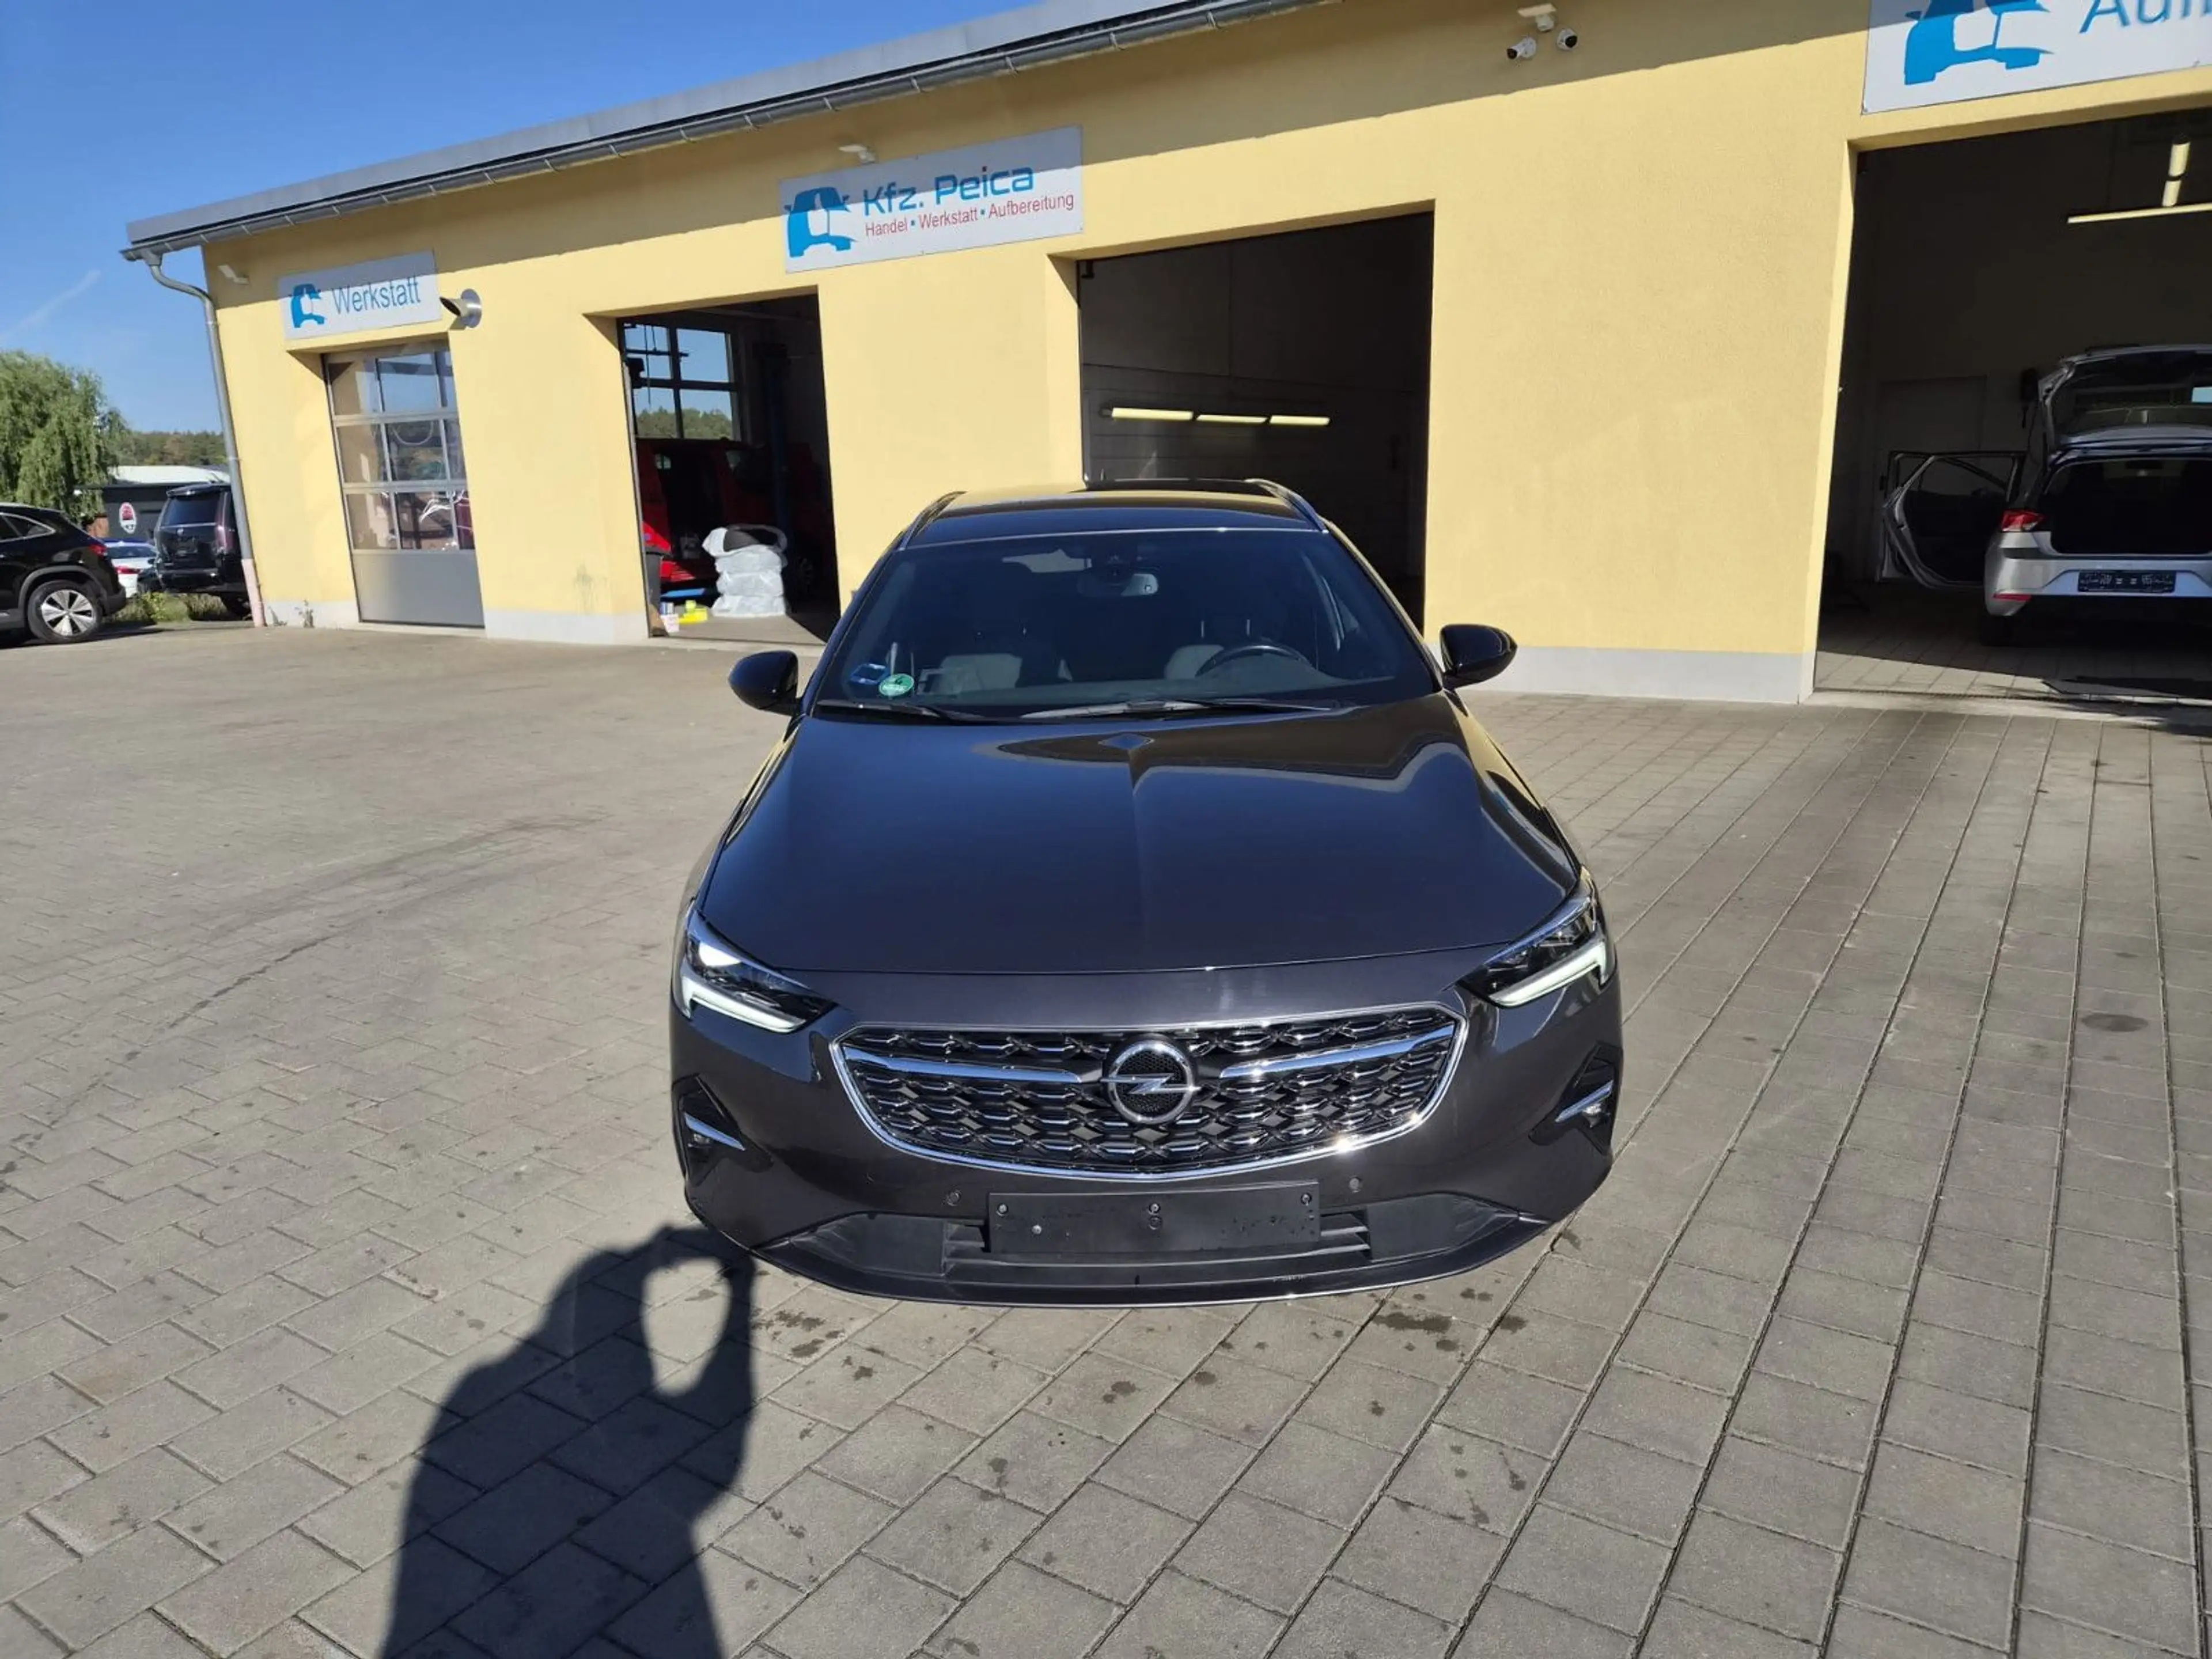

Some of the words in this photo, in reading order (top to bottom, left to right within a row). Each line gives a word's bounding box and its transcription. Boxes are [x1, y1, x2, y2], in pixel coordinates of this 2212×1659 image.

[2078, 0, 2212, 33] Au
[863, 181, 924, 215] Kfz.
[934, 166, 1034, 204] Peica
[865, 218, 907, 236] Handel
[918, 208, 978, 229] Werkstatt
[988, 194, 1074, 218] Aufbereitung
[332, 274, 421, 315] Werkstatt
